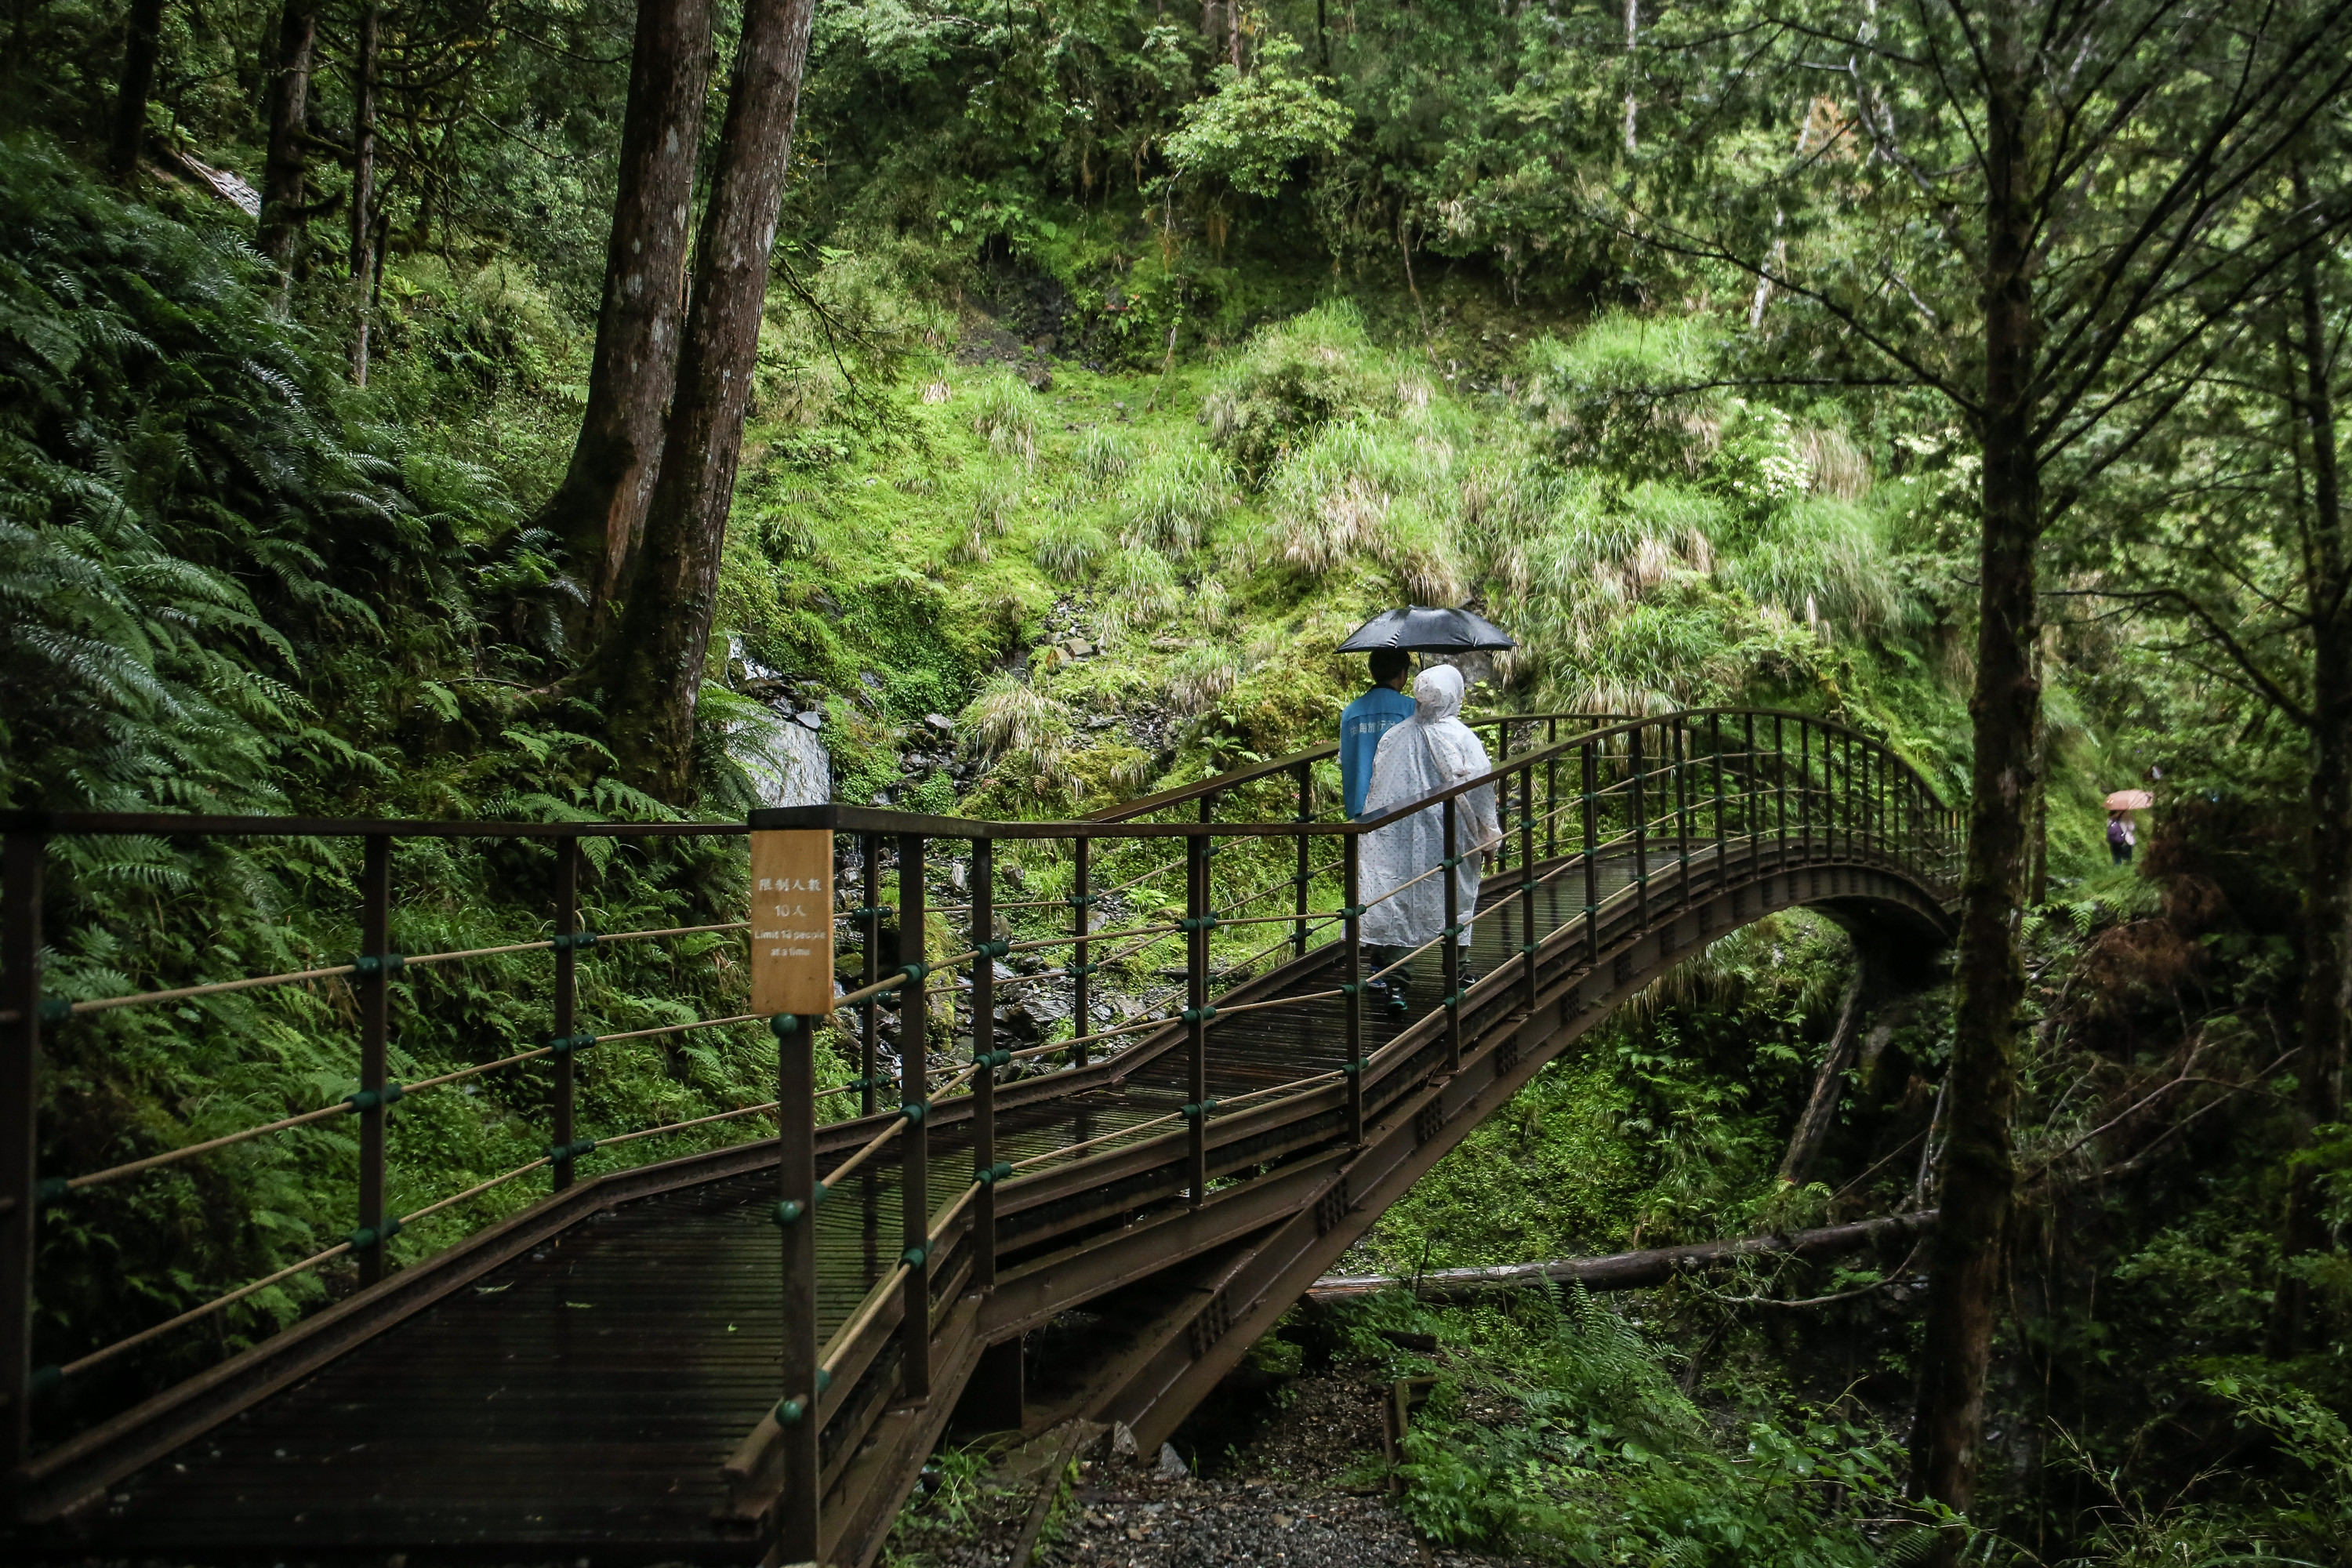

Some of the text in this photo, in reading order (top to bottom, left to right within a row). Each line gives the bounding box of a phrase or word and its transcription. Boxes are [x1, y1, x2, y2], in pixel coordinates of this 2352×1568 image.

[759, 877, 822, 891] 限制人數
[754, 930, 779, 939] Limit
[793, 931, 826, 942] people
[771, 948, 779, 956] at
[789, 948, 811, 956] time
